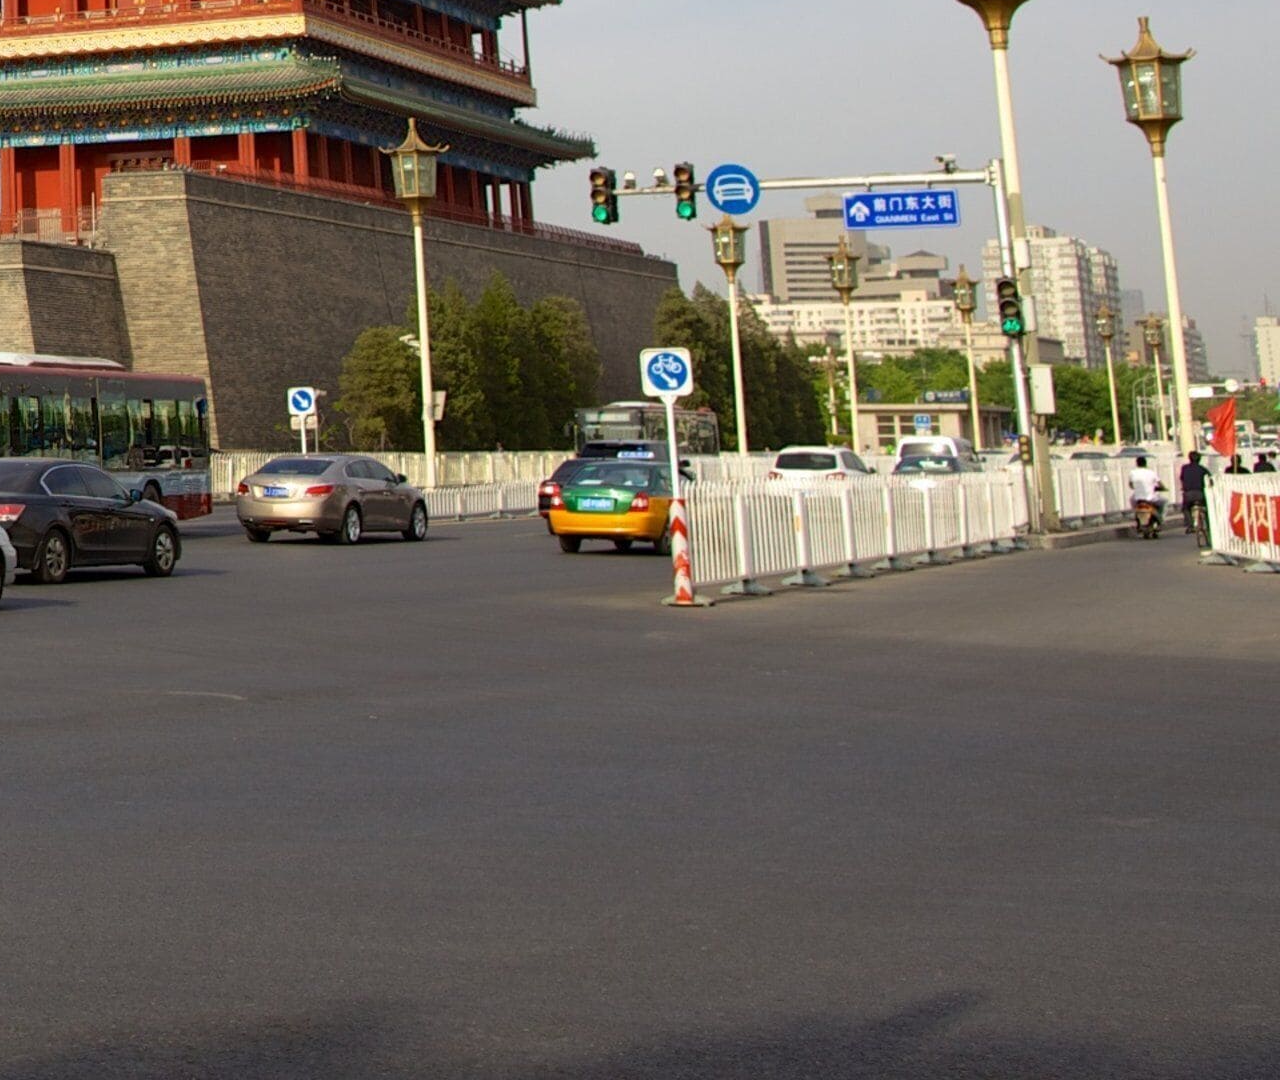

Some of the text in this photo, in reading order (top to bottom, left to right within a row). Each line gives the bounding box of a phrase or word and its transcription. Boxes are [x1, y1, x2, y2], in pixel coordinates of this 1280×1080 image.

[873, 194, 952, 212] 前门东大街
[875, 212, 954, 224] QIANMEN East St
